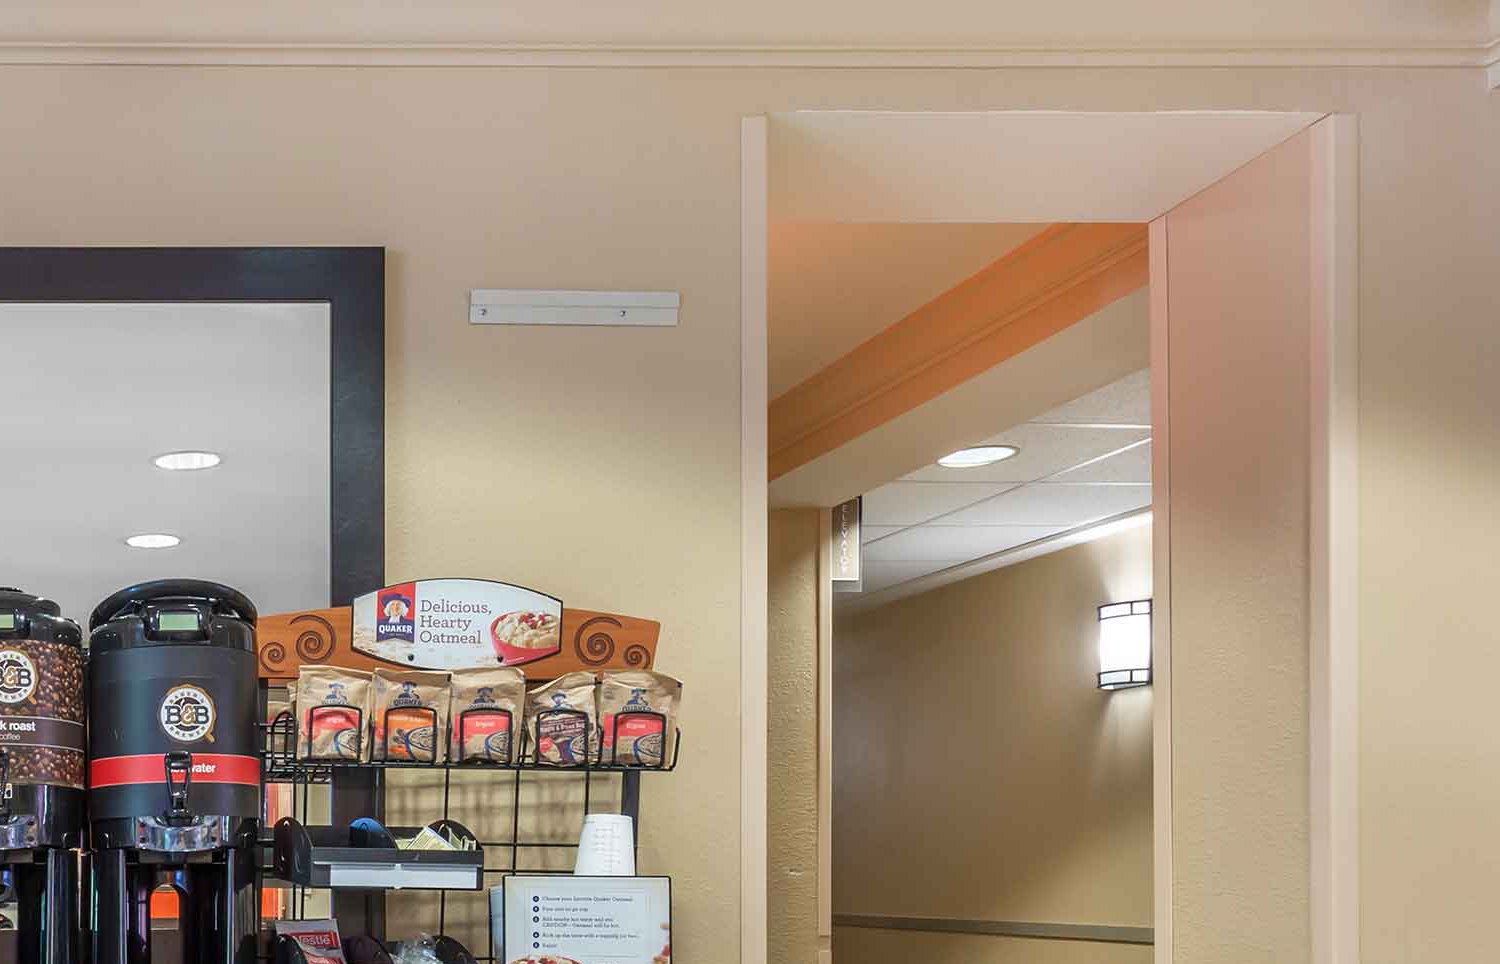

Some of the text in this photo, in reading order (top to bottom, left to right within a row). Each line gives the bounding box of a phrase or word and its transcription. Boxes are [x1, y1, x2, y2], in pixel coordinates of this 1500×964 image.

[420, 599, 492, 615] Delicious,
[378, 624, 413, 634] QUAKER
[420, 615, 472, 632] Hearty
[420, 630, 481, 645] Oatmeal
[164, 704, 209, 726] B&B
[9, 721, 36, 732] roast
